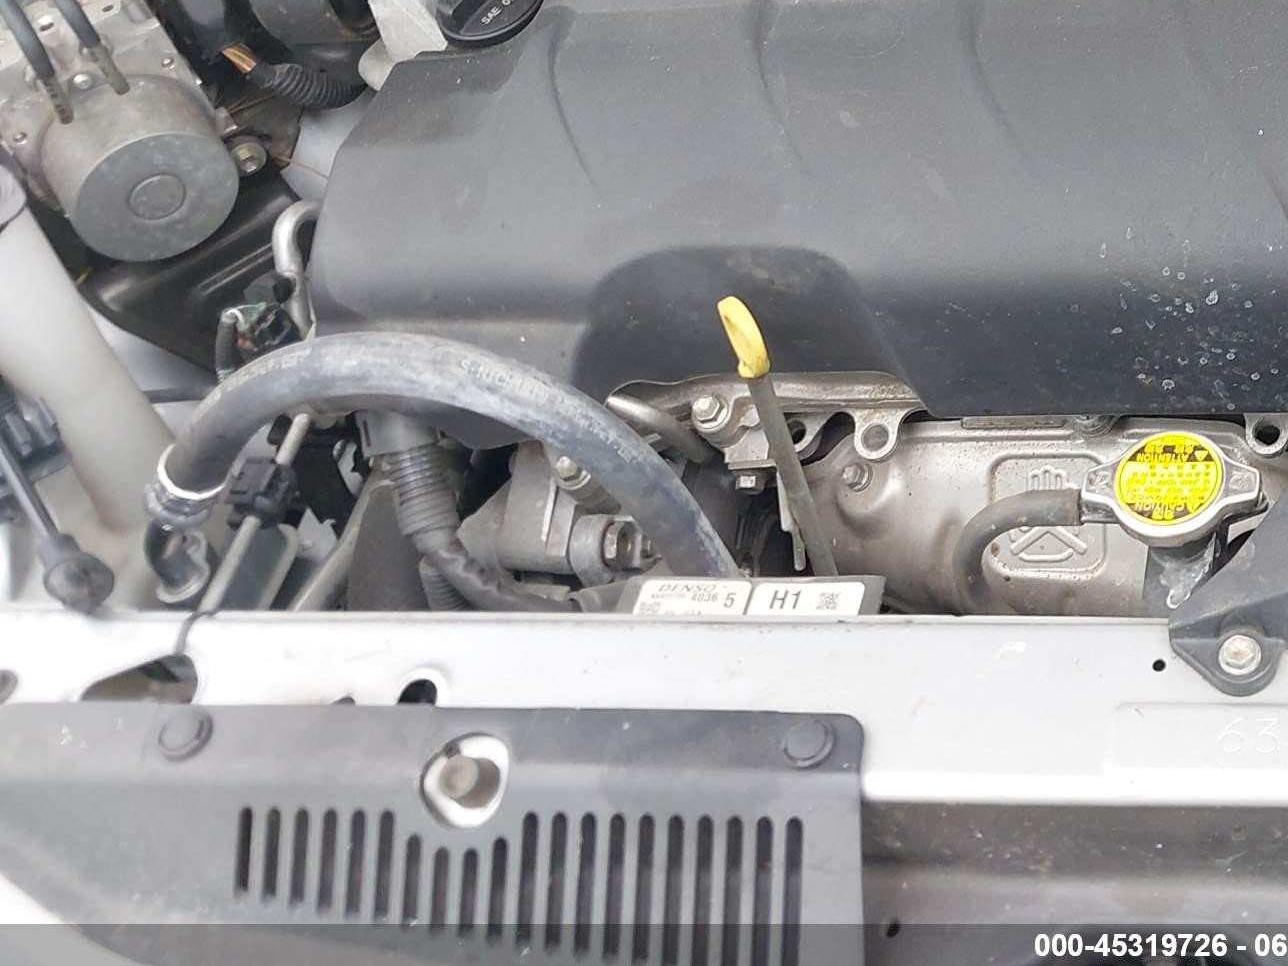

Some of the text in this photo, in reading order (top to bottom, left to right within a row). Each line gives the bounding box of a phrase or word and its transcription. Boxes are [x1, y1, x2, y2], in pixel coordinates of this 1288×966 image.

[481, 6, 502, 25] SAE
[1136, 452, 1189, 462] ATTENTION
[658, 584, 717, 593] DENSO
[723, 592, 737, 609] 5
[769, 590, 802, 610] H1
